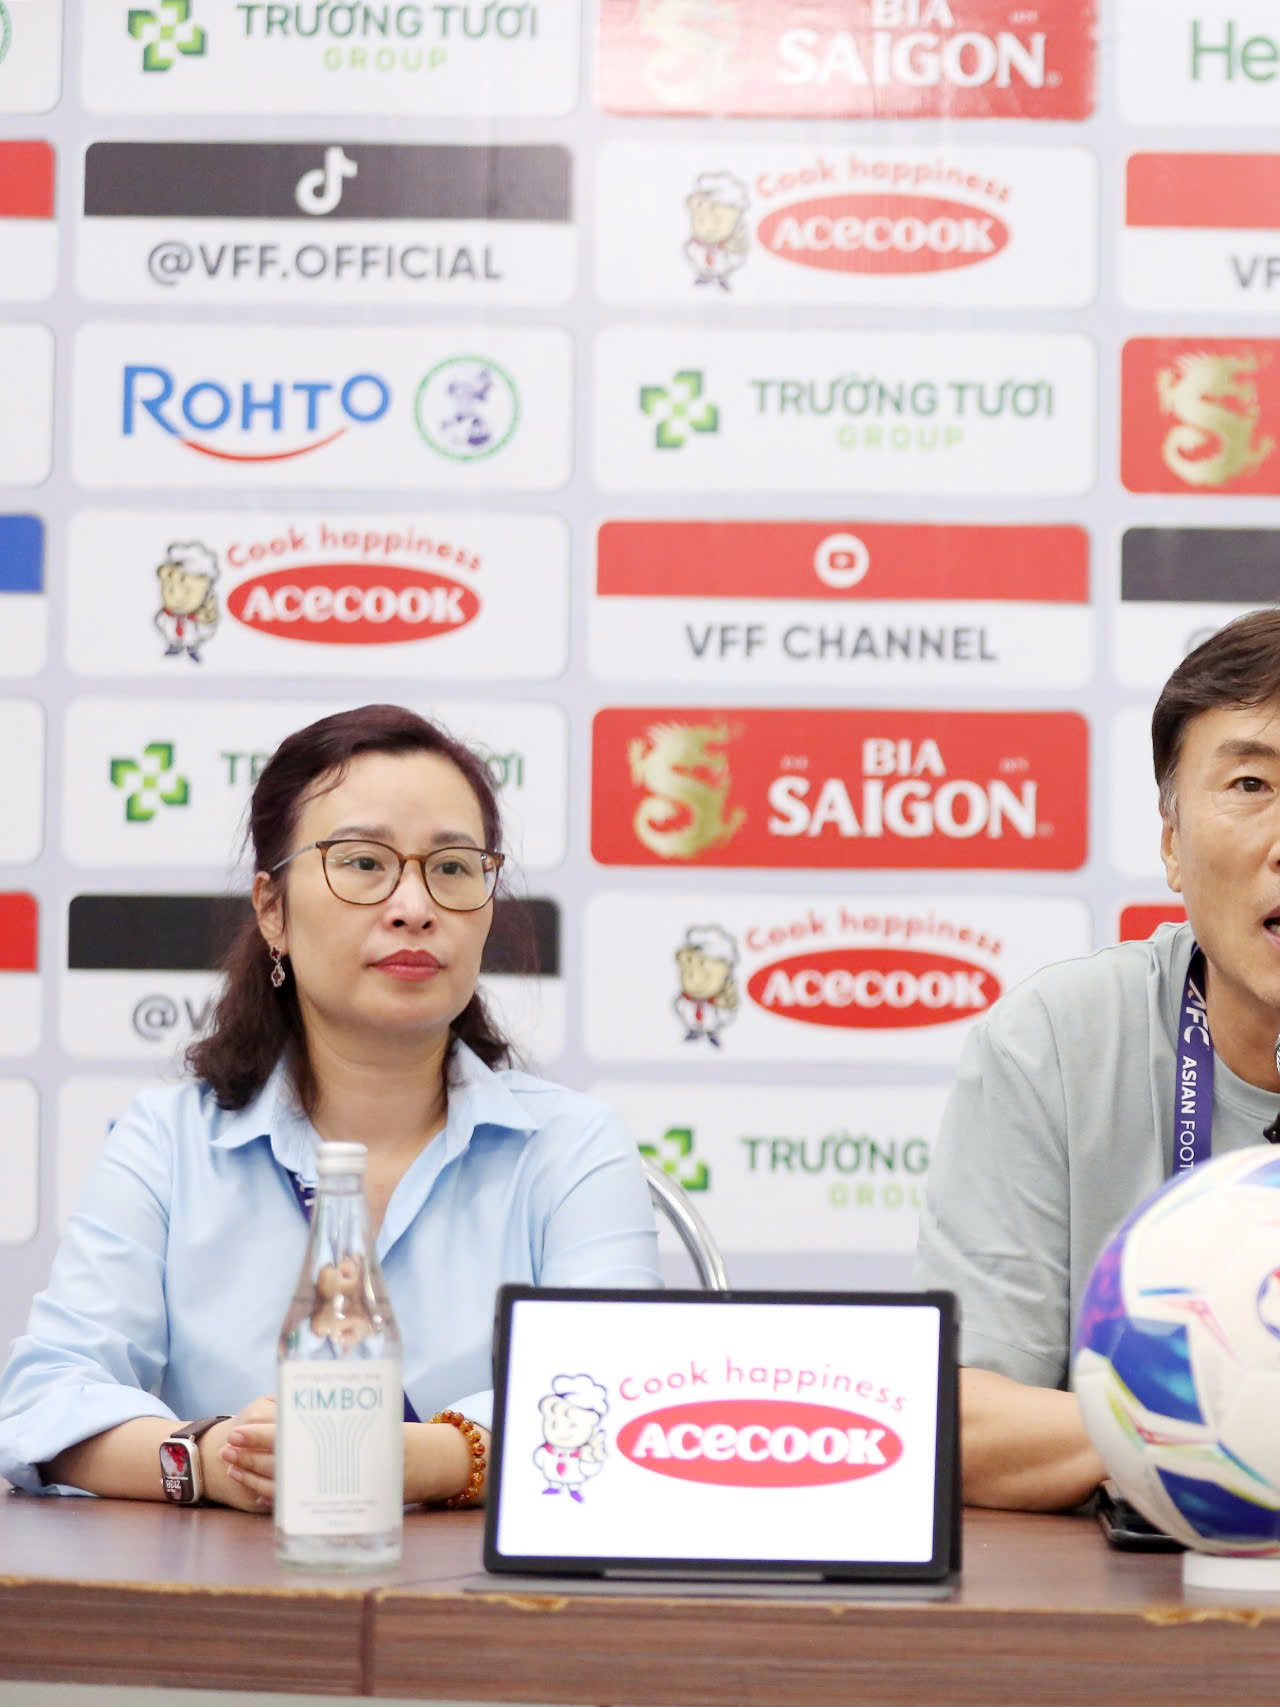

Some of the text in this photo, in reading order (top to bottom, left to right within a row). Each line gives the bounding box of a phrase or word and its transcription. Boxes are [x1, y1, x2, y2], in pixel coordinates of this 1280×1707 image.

[323, 48, 448, 72] GROUP
[774, 28, 1050, 89] SAIGON
[756, 154, 1012, 204] Cook happiness
[148, 241, 500, 286] @VFF.OFFICIAL
[123, 365, 390, 437] ROHTO
[948, 379, 1053, 418] TƯƠI
[838, 424, 962, 450] GROUP
[227, 525, 483, 572] Cook happiness
[686, 625, 995, 661] VFF CHANNEL
[863, 738, 946, 776] BIA
[767, 778, 1038, 838] SAIGON
[746, 908, 1003, 955] Cook happiness
[1180, 1055, 1198, 1115] ASIAN
[1179, 1119, 1196, 1175] FOOT
[828, 1181, 923, 1209] GRO
[294, 1387, 383, 1410] KIMBOI
[619, 1357, 905, 1412] Cook happiness
